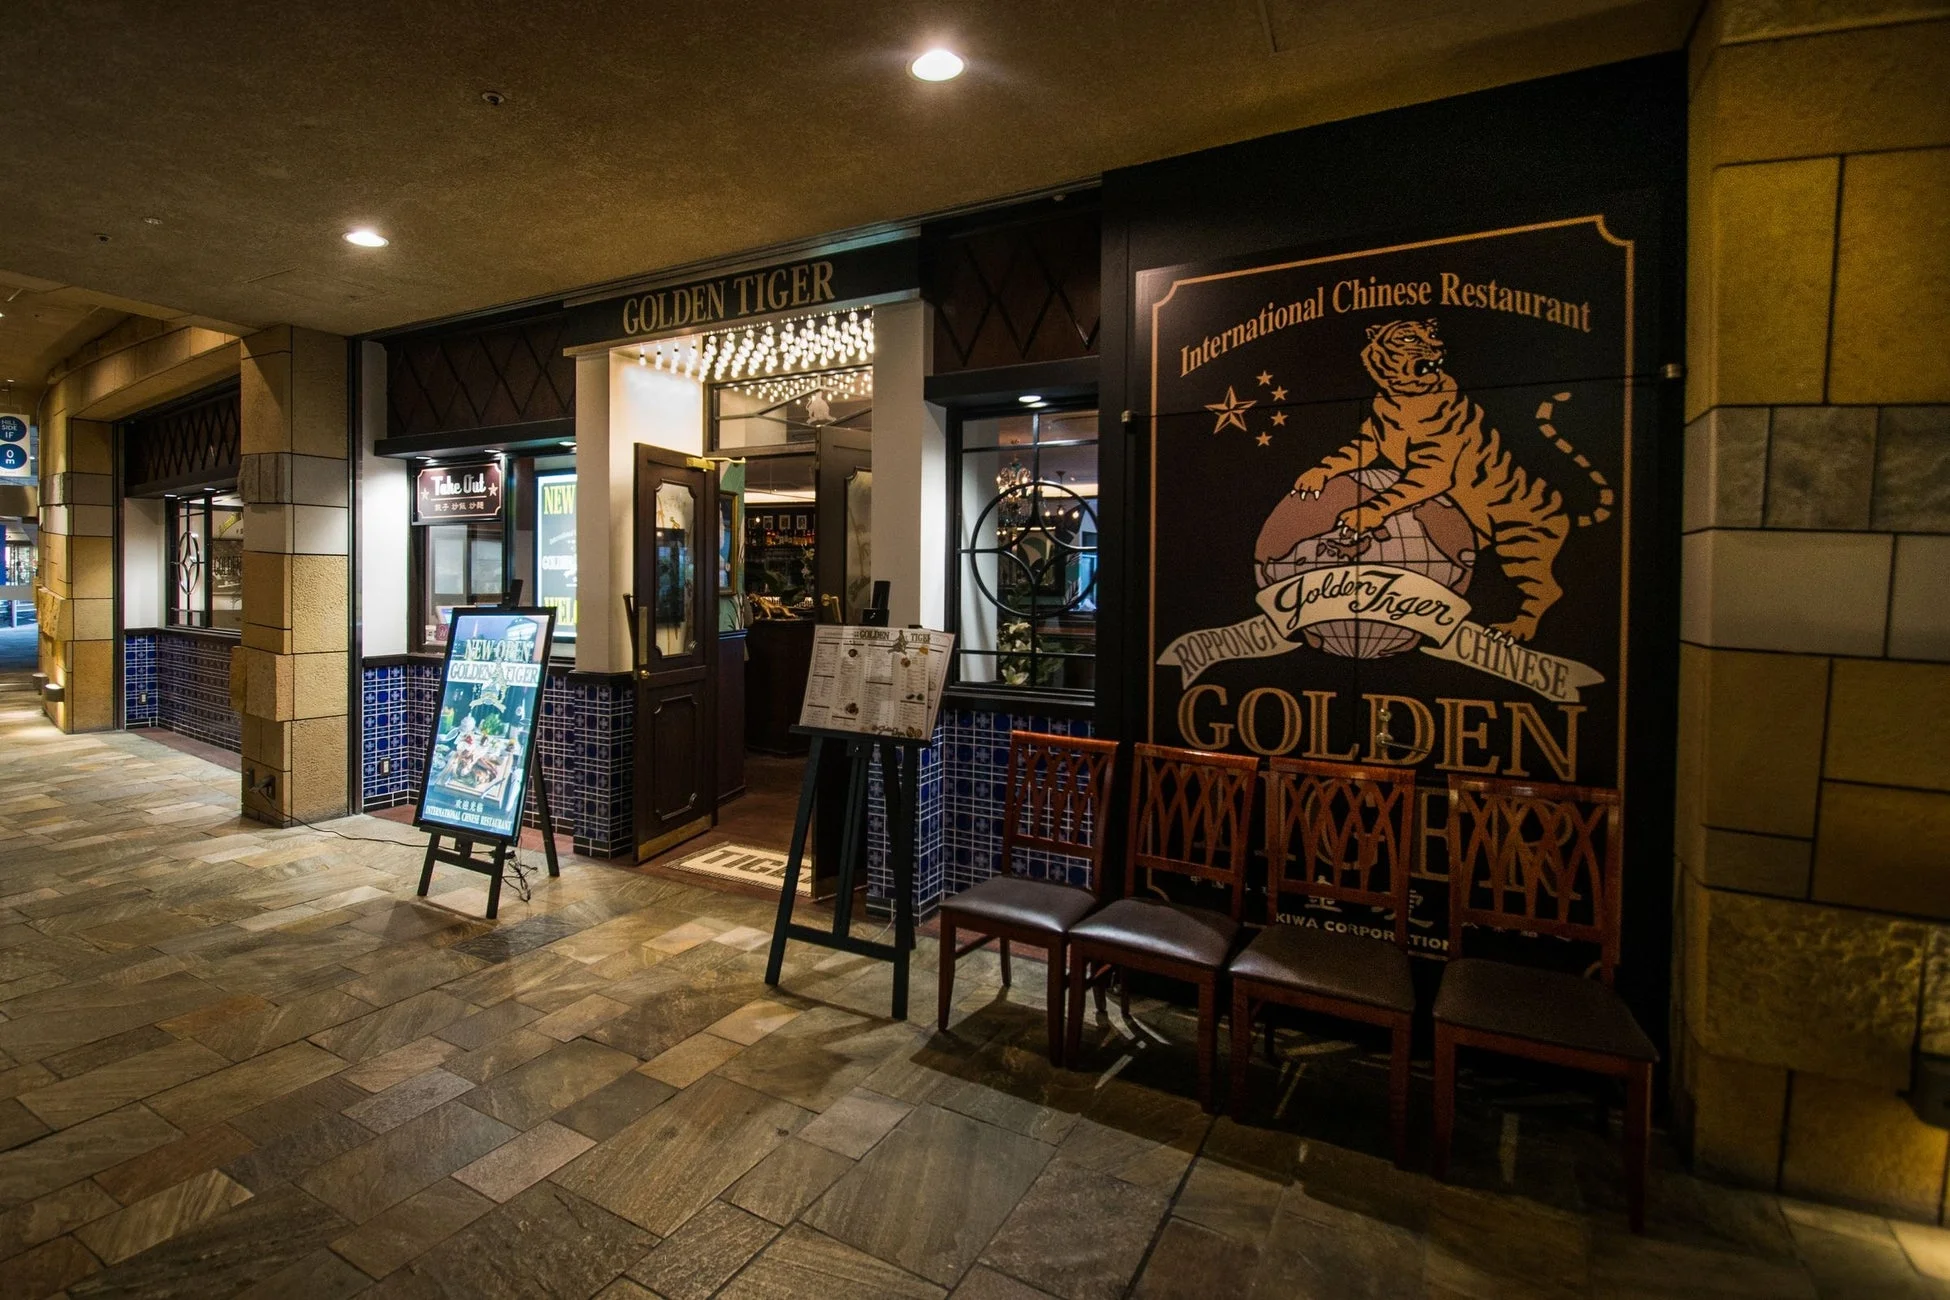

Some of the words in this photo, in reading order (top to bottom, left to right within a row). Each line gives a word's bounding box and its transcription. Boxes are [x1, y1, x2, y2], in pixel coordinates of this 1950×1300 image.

[623, 280, 725, 334] GOLDEN
[733, 260, 835, 316] TIGER
[1179, 287, 1324, 377] International
[1332, 276, 1431, 314] Chinese
[1440, 272, 1593, 333] Restaurant
[430, 475, 462, 496] Take
[463, 473, 486, 493] Out
[544, 484, 577, 515] NEW
[1275, 571, 1377, 631] Golden
[1349, 570, 1453, 626] Tiger
[464, 639, 494, 660] NEW
[859, 630, 890, 641] GOLDEN
[1173, 617, 1278, 680] ROPPONGI
[450, 662, 496, 681] GOLDEN
[504, 665, 538, 684] TIGER
[1455, 625, 1569, 700] CHINESE
[1177, 684, 1588, 784] GOLDEN
[1275, 911, 1318, 930] KIWA
[1323, 920, 1449, 951] CORPORTION
